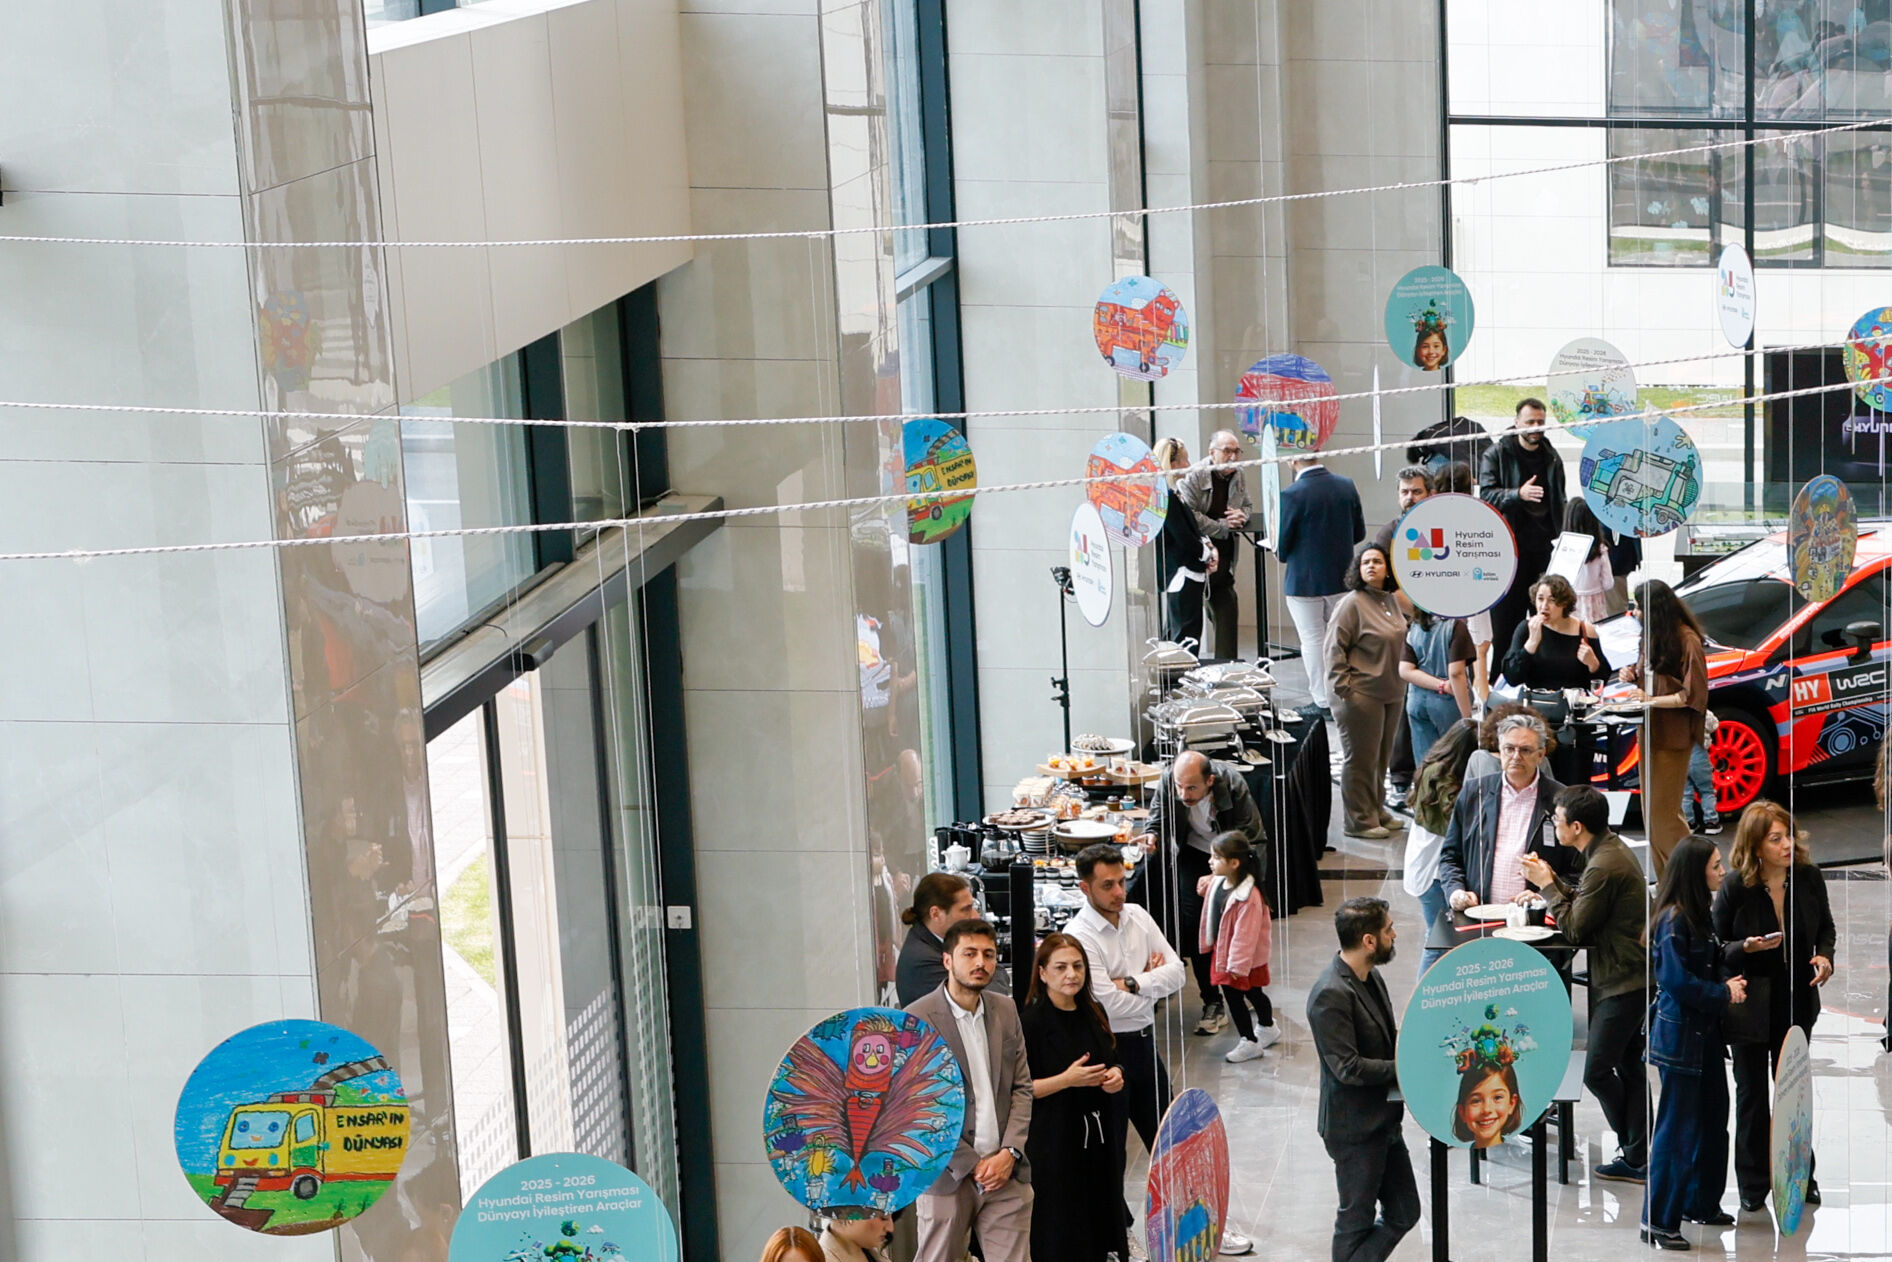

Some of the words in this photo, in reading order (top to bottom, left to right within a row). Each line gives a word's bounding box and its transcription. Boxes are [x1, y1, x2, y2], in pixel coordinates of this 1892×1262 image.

[1456, 531, 1493, 539] Hyundai
[1456, 551, 1500, 559] Yarışması
[1794, 679, 1819, 701] HY
[1456, 964, 1480, 976] 2025
[1489, 959, 1514, 971] 2026
[1423, 980, 1464, 996] Hyundai
[1466, 975, 1496, 988] Resim
[1499, 968, 1547, 982] Yarışması
[1421, 995, 1462, 1009] Dünyayı
[1464, 986, 1511, 1003] İyileştiren
[1512, 980, 1549, 993] Araçlar
[343, 1134, 402, 1152] DÜNYASI
[521, 1178, 552, 1190] 2025
[563, 1175, 596, 1187] 2026
[478, 1197, 532, 1209] Hyundai
[535, 1192, 574, 1202] Resim
[577, 1186, 639, 1200] Yarışması
[478, 1210, 530, 1222] Dünyayı
[533, 1204, 593, 1218] İyileştiren
[596, 1199, 642, 1211] Araçlar
